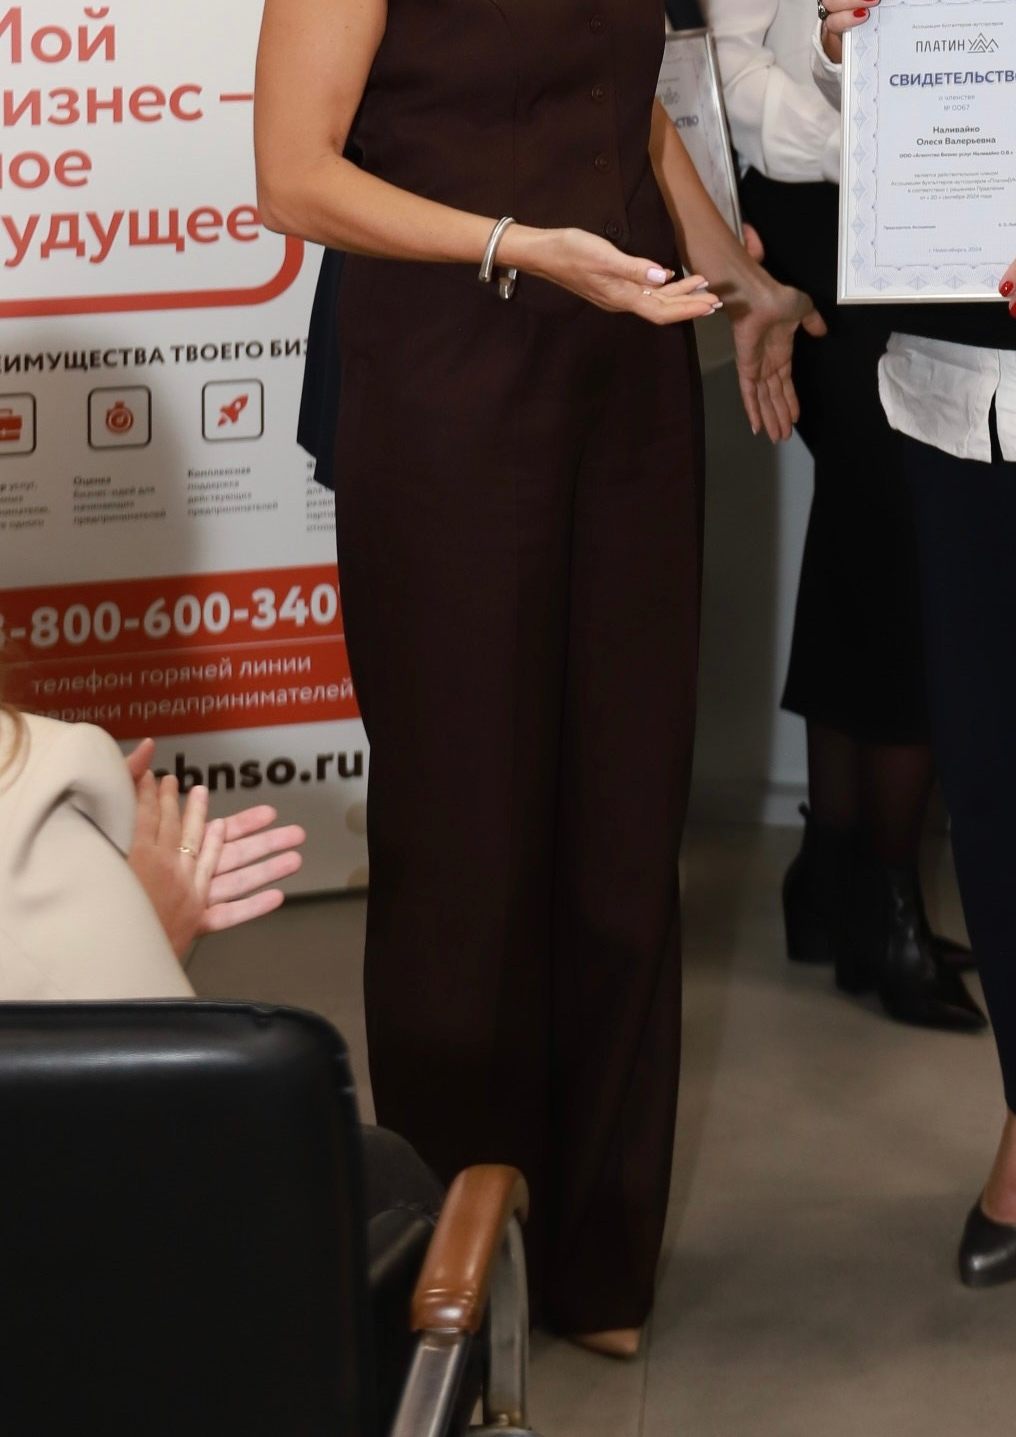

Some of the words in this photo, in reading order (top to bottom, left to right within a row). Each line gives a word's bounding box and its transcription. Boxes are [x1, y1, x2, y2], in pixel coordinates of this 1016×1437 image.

[3, 83, 203, 127] изнес
[916, 138, 943, 146] Олеся
[945, 137, 996, 146] Валерьевна
[933, 125, 980, 134] Наливайко
[0, 149, 92, 190] ое
[1, 204, 262, 268] удущее
[0, 346, 165, 373] ИМУЩЕСТВА
[170, 341, 264, 363] ТВОЕГО
[270, 338, 308, 358] БИ
[0, 583, 338, 649] -800-600-340
[31, 669, 133, 696] телефон
[141, 657, 232, 689] горячей
[239, 655, 311, 678] линии
[129, 677, 353, 722] предпринимателей
[154, 750, 364, 794] bnso.ru
